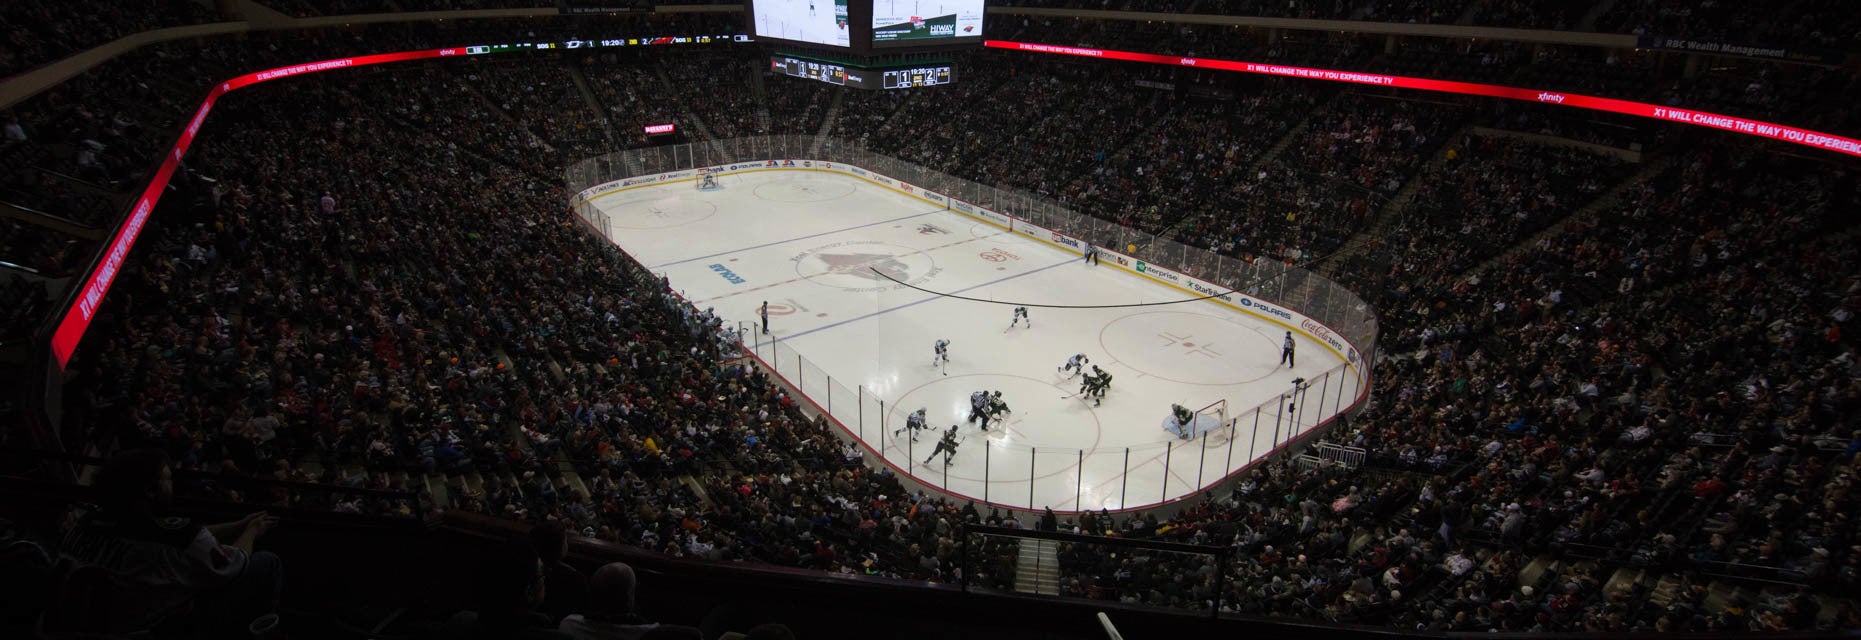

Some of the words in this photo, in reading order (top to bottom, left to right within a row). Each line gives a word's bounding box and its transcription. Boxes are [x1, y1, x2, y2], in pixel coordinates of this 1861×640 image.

[930, 24, 954, 32] HIWAY
[1665, 39, 1686, 49] RBC
[1687, 41, 1720, 52] Wealth
[1721, 44, 1785, 58] Management
[1181, 58, 1196, 66] xfinity
[927, 70, 933, 80] 2
[1270, 67, 1295, 75] CHANGE
[1309, 70, 1324, 78] WAY
[1340, 73, 1382, 84] EXPERIENCE
[1538, 91, 1565, 104] xfinity
[1654, 108, 1666, 117] X1
[1668, 110, 1691, 122] WILL
[1692, 114, 1733, 128] CHANGE
[1735, 121, 1754, 132] THE
[1757, 124, 1781, 136] WAY
[1782, 129, 1804, 142] YOU
[1062, 235, 1079, 248] bank
[96, 258, 115, 292] CHANGE
[1138, 262, 1183, 280] enterprise
[1254, 302, 1291, 320] POLARIS
[1328, 337, 1342, 350] zero
